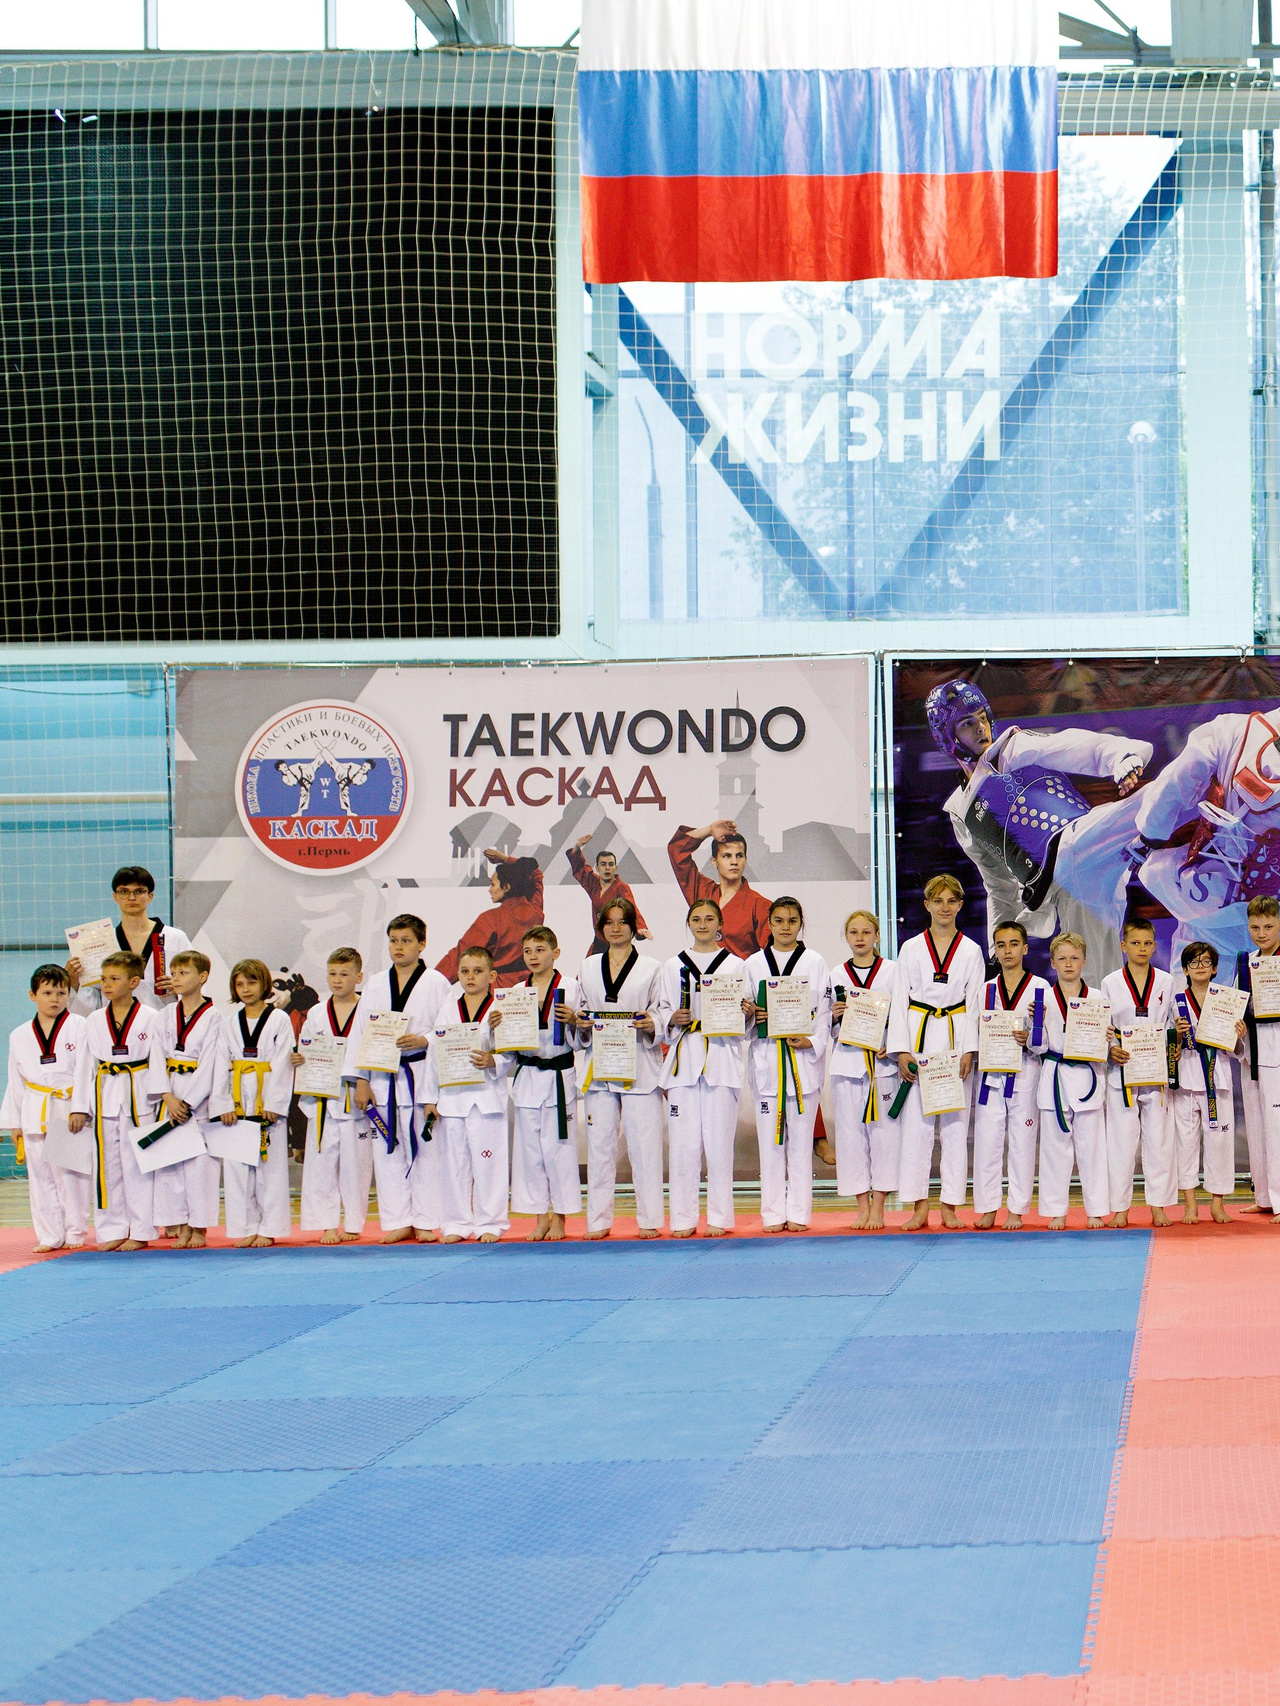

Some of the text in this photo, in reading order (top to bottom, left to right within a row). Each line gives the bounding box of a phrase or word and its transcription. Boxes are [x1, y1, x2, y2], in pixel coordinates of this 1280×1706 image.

[690, 310, 1001, 380] НОРМА
[690, 391, 1001, 464] ЖИЗНИ
[285, 729, 367, 752] TAEKWONDO
[443, 706, 806, 758] TAEKWONDO
[254, 711, 403, 813] ПЛАСТИКИ И БОЕВЫХ ИСКУССТВ
[449, 765, 667, 811] КАСКАД
[269, 819, 378, 841] КАСКАД
[297, 846, 351, 858] г.Пермь
